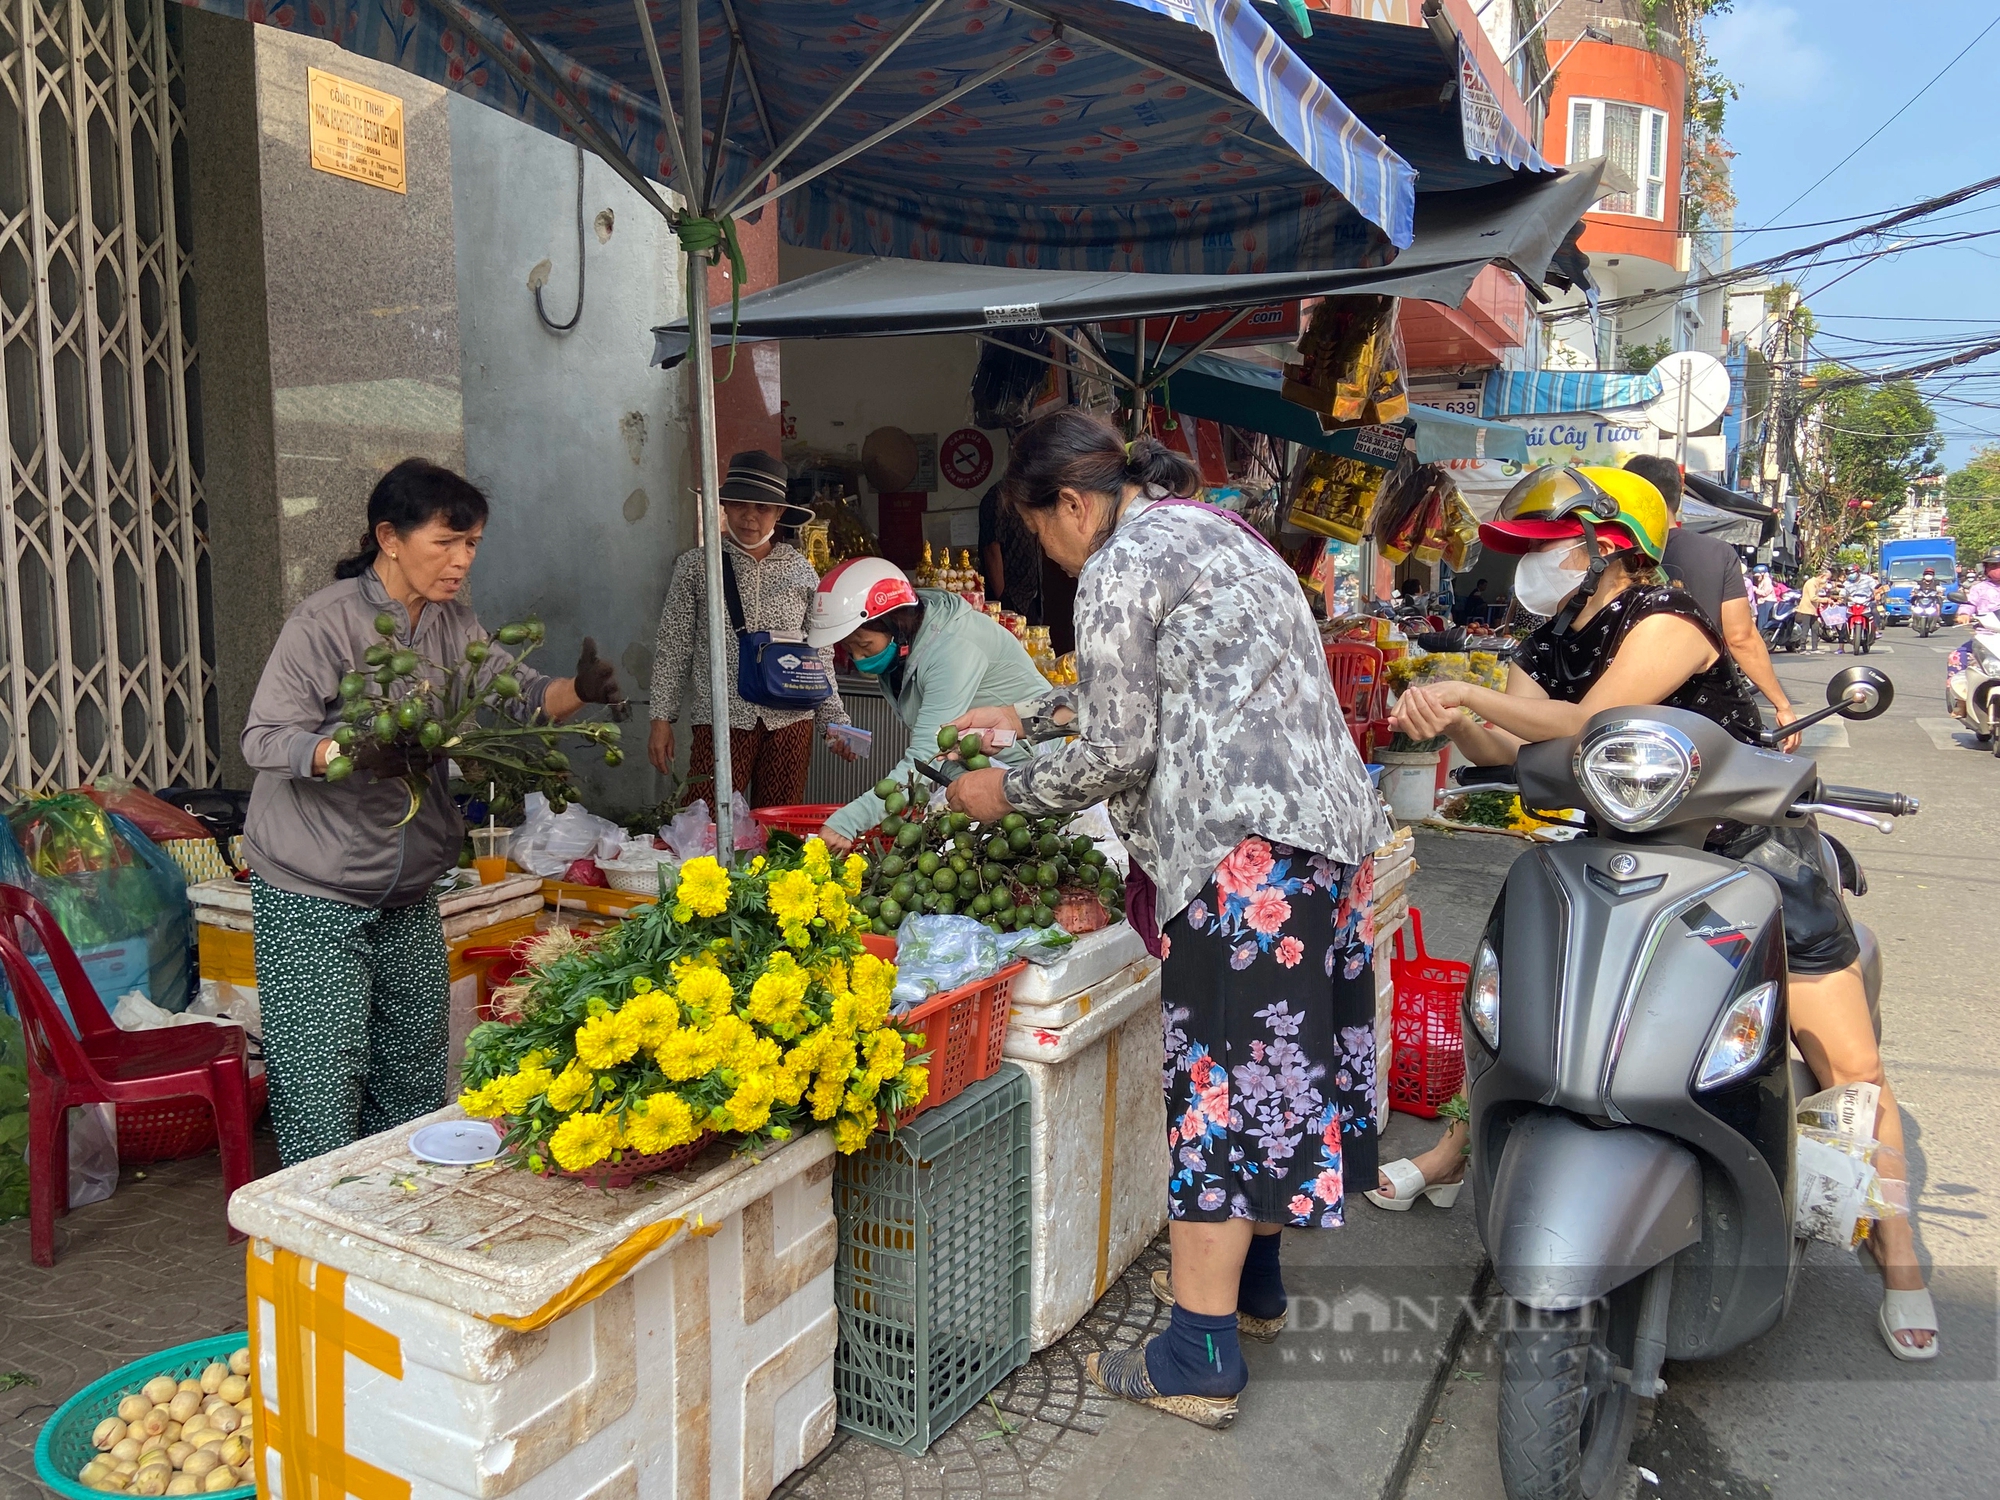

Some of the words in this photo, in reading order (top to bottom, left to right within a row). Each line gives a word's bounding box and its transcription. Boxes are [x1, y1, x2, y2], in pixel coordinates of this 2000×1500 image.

[329, 87, 351, 107] CÔNG
[352, 96, 362, 111] TY
[364, 99, 385, 118] TNHH
[1010, 306, 1036, 314] 203
[1247, 311, 1284, 325] .com
[1445, 401, 1477, 415] 639
[1526, 427, 1546, 446] ái
[1549, 425, 1588, 451] Cây
